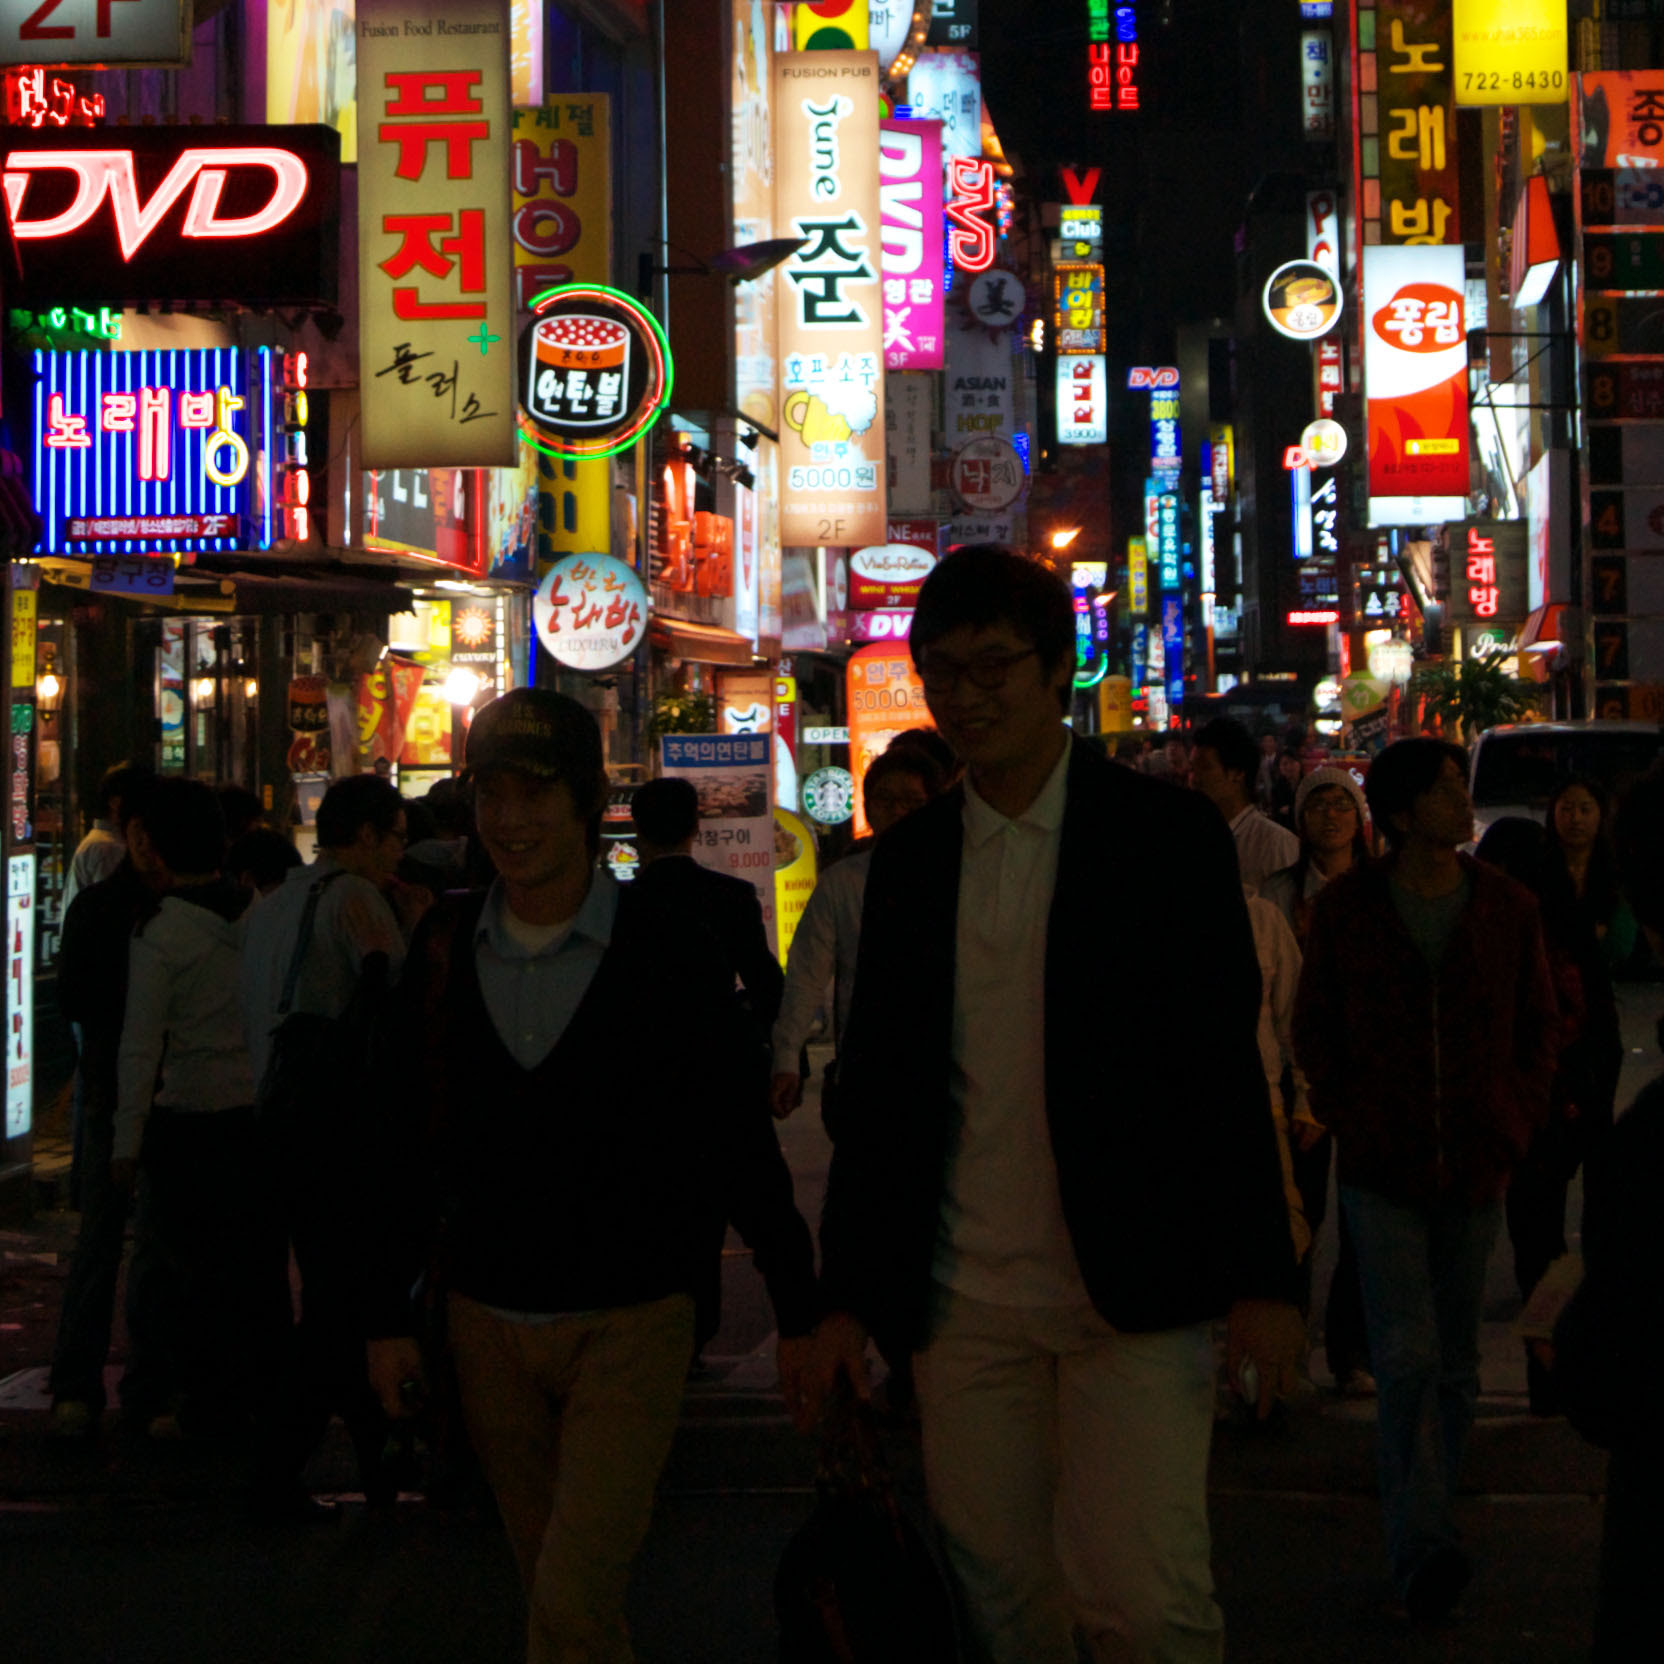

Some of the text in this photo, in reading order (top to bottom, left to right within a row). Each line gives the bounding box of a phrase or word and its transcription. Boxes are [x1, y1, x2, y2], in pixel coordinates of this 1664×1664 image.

[361, 18, 501, 38] Fusion Food Restaurant
[948, 25, 973, 39] 5F
[783, 67, 872, 80] FUSION PUB
[1463, 70, 1562, 92] 722-8430
[1386, 19, 1452, 244] 노래방
[806, 98, 840, 199] June
[3, 147, 309, 263] DVD
[377, 69, 491, 323] 퓨전
[880, 128, 924, 275] DVD
[944, 155, 996, 272] DVD
[1062, 220, 1101, 240] Club
[788, 216, 878, 326] 준
[1384, 295, 1460, 347] 풍림
[1589, 306, 1613, 344] 8
[377, 340, 499, 426] 플러스
[954, 376, 1006, 393] ASIAN
[1128, 366, 1182, 390] DVD
[536, 368, 622, 417] 연탄불
[956, 413, 1003, 432] HOF
[45, 385, 249, 487] 노래방
[791, 467, 876, 490] 5000원
[202, 515, 227, 536] 2F
[817, 518, 847, 540] 2F
[1465, 526, 1501, 618] 노래방
[868, 615, 915, 638] DV
[865, 661, 910, 685] 안주
[810, 727, 850, 742] OPEN
